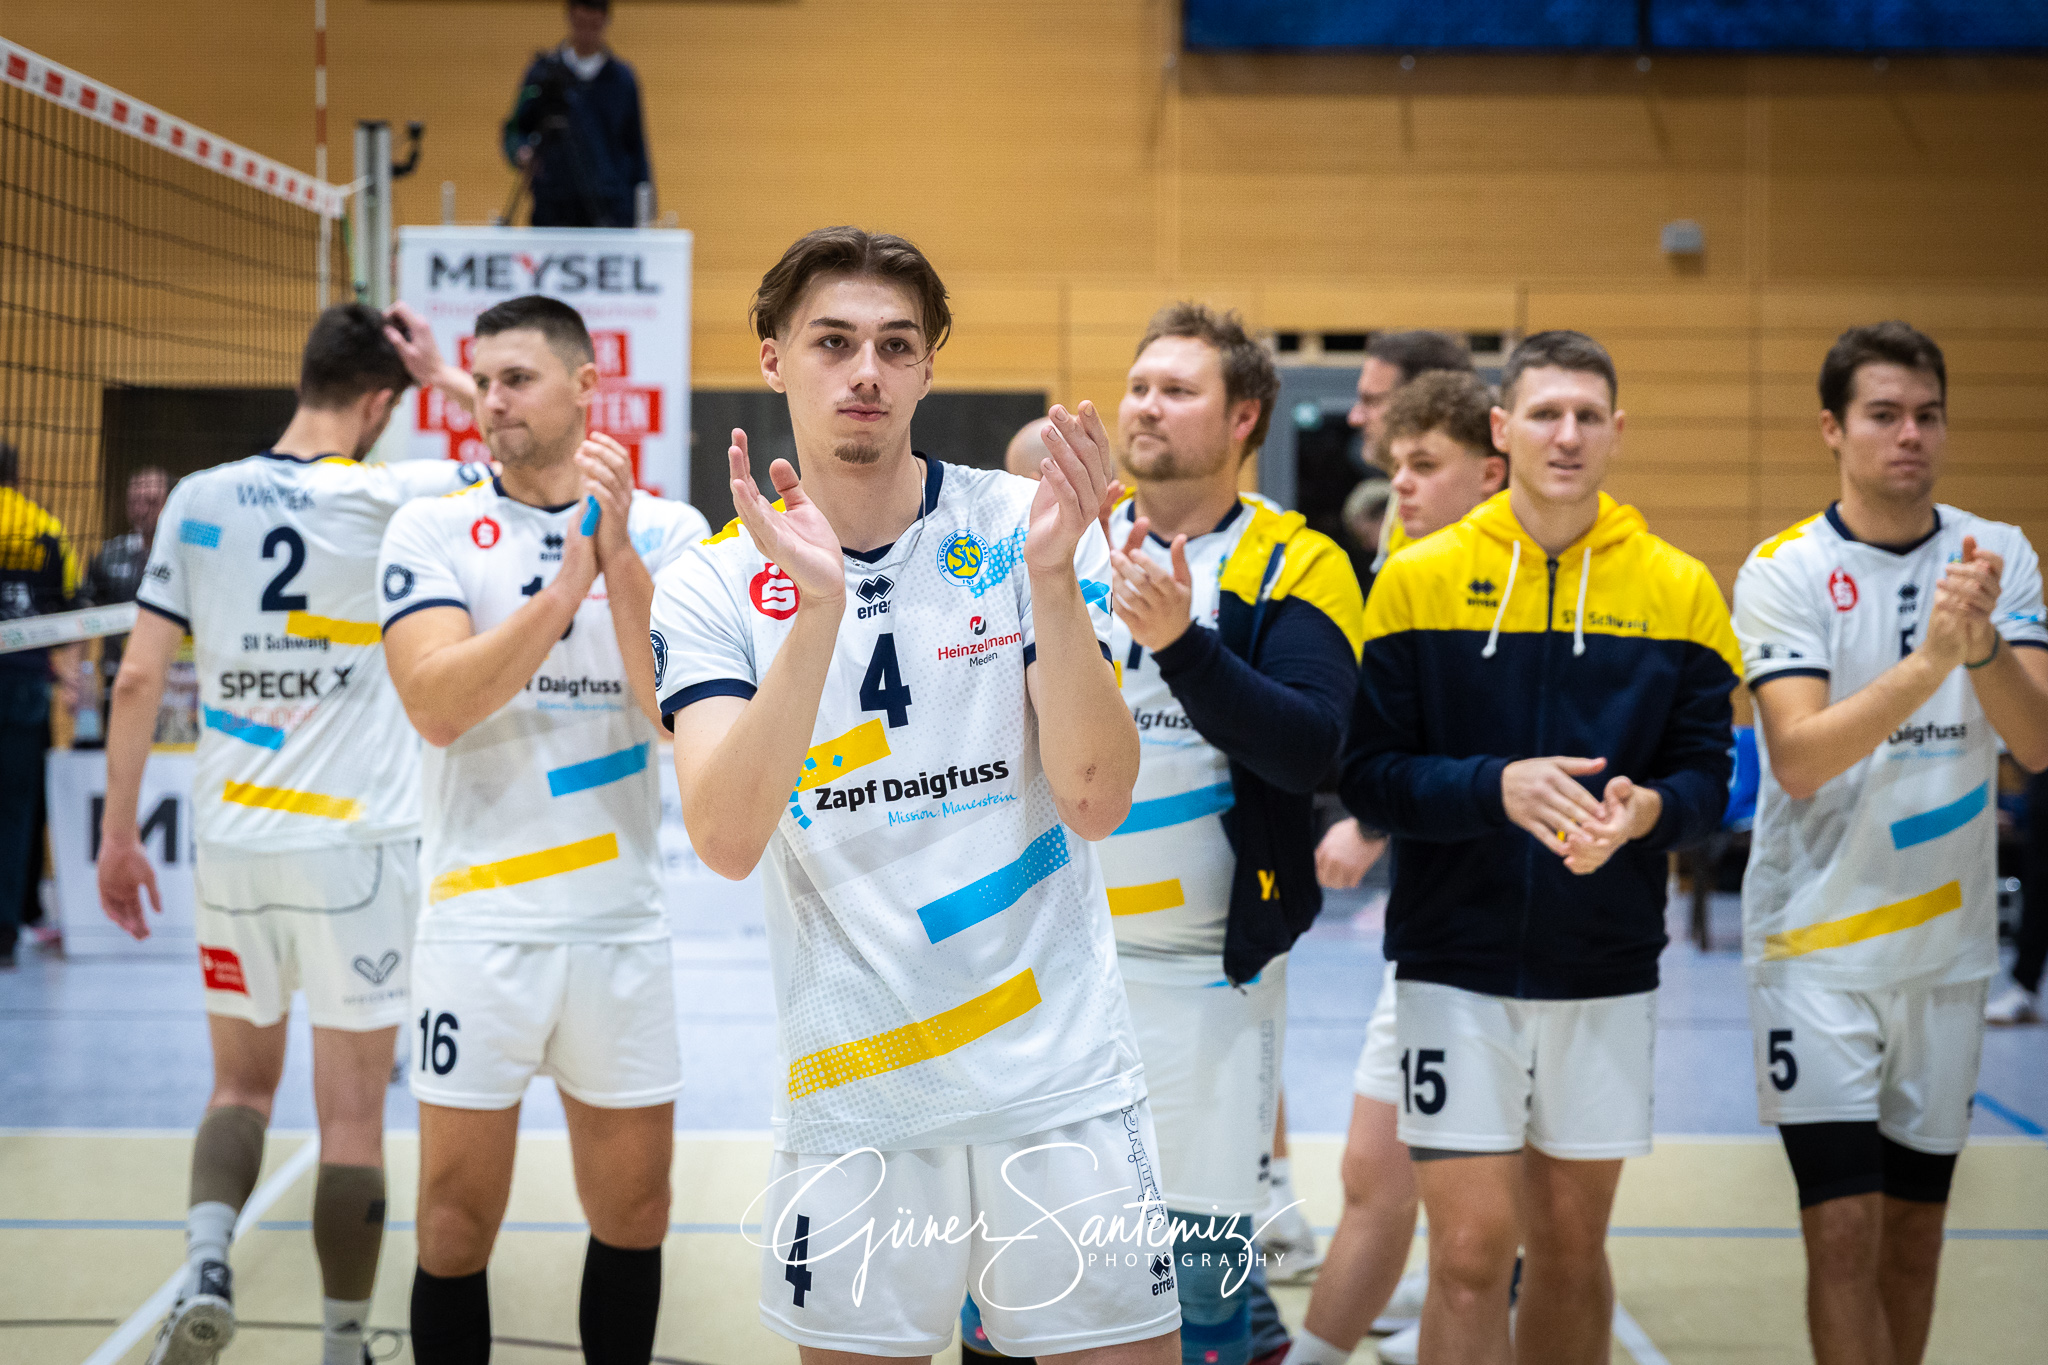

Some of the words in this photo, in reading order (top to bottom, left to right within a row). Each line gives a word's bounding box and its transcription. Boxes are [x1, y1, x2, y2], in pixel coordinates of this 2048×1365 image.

[430, 254, 658, 294] MEYSEL
[261, 526, 308, 612] 2
[938, 632, 1022, 660] Heinzelmann
[219, 669, 322, 700] SPECK
[539, 676, 622, 698] Daigfuss
[859, 632, 912, 729] 4
[815, 779, 877, 812] Zapf
[883, 760, 1009, 802] Daigfuss
[888, 810, 941, 827] Mission:
[941, 792, 1018, 818] Mauerstein
[420, 1009, 459, 1075] 16
[1769, 1029, 1798, 1091] 5
[1401, 1048, 1447, 1116] 15
[785, 1213, 812, 1309] 4
